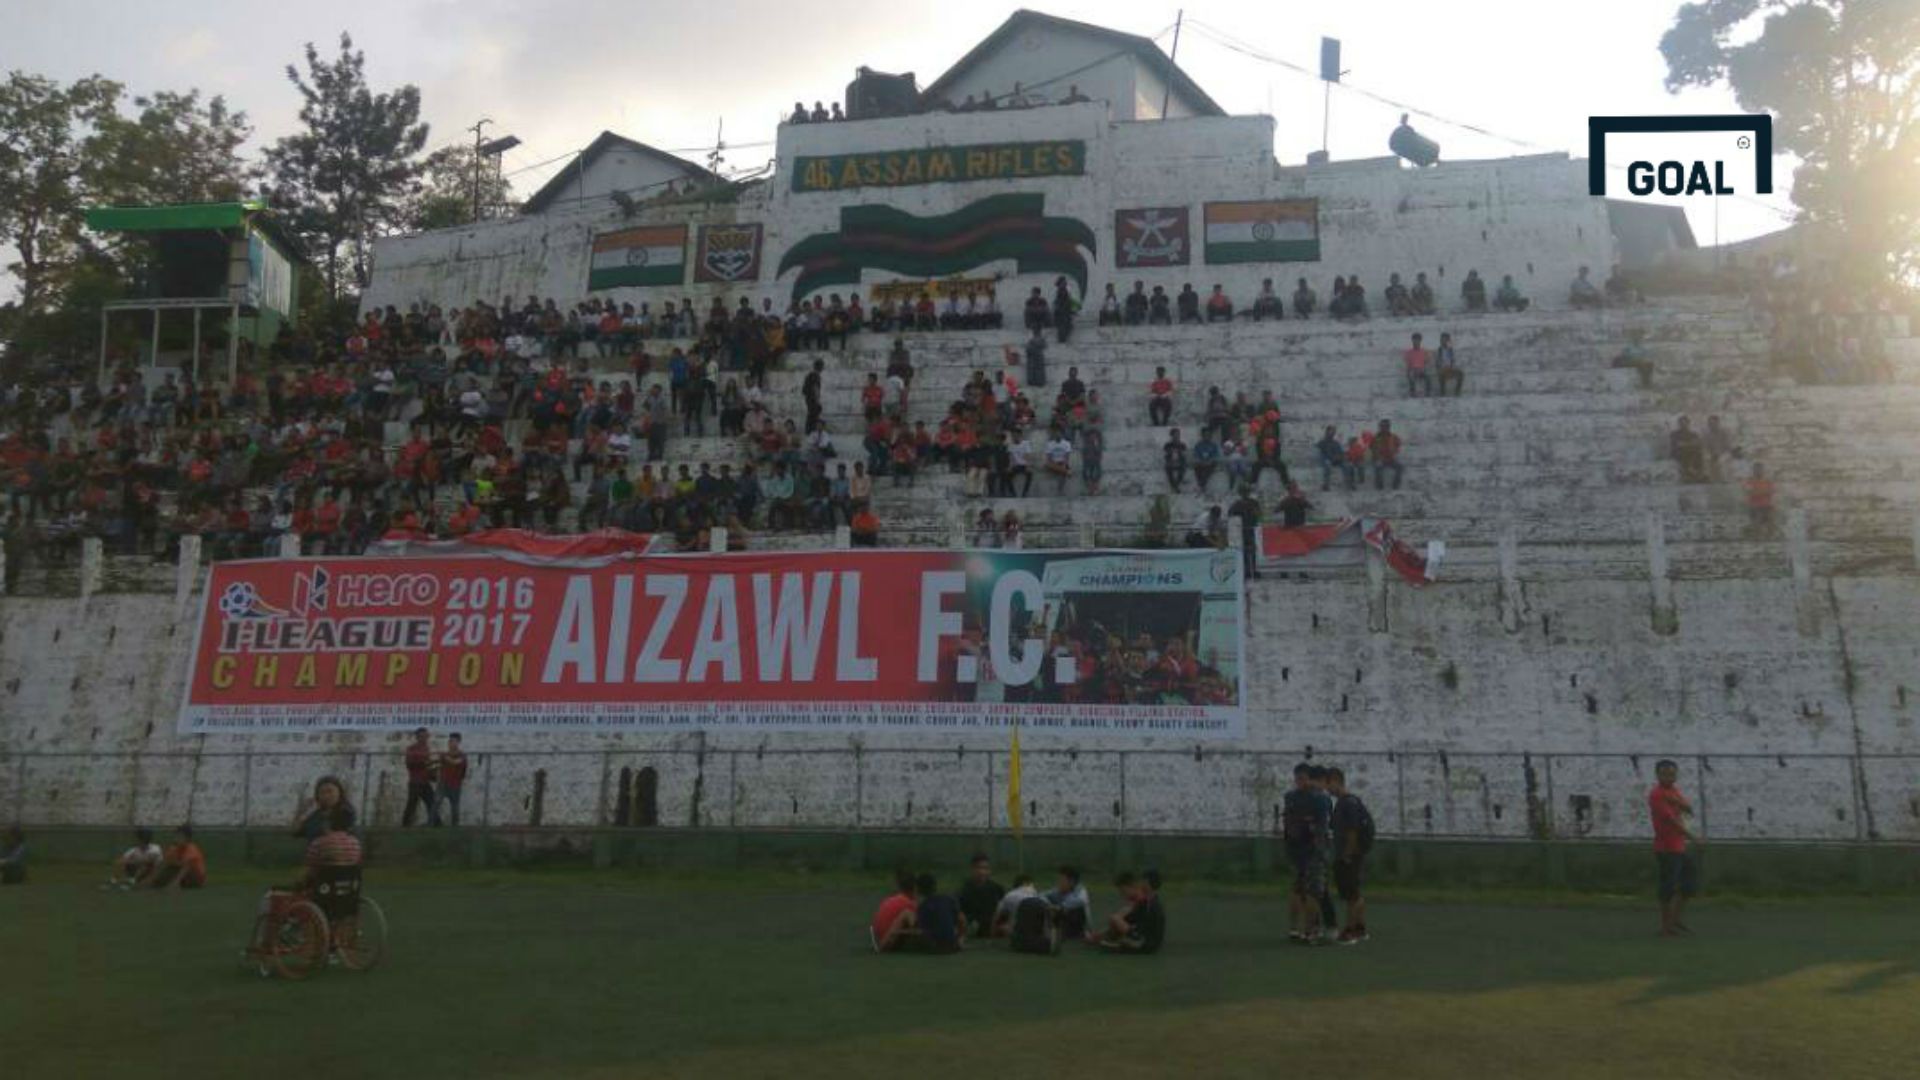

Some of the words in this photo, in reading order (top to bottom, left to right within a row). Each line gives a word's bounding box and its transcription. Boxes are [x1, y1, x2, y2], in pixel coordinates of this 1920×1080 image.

[842, 151, 957, 187] ASSAM
[967, 145, 1074, 177] RIFLES
[336, 572, 441, 607] Hero
[446, 576, 535, 610] 2016
[1080, 572, 1183, 586] CHAMPIONS
[219, 616, 434, 653] I-LEAGUE
[441, 613, 532, 646] 2017
[541, 571, 878, 683] AIZAWL
[917, 569, 1077, 687] F.C.
[212, 651, 524, 689] CHAMPION
